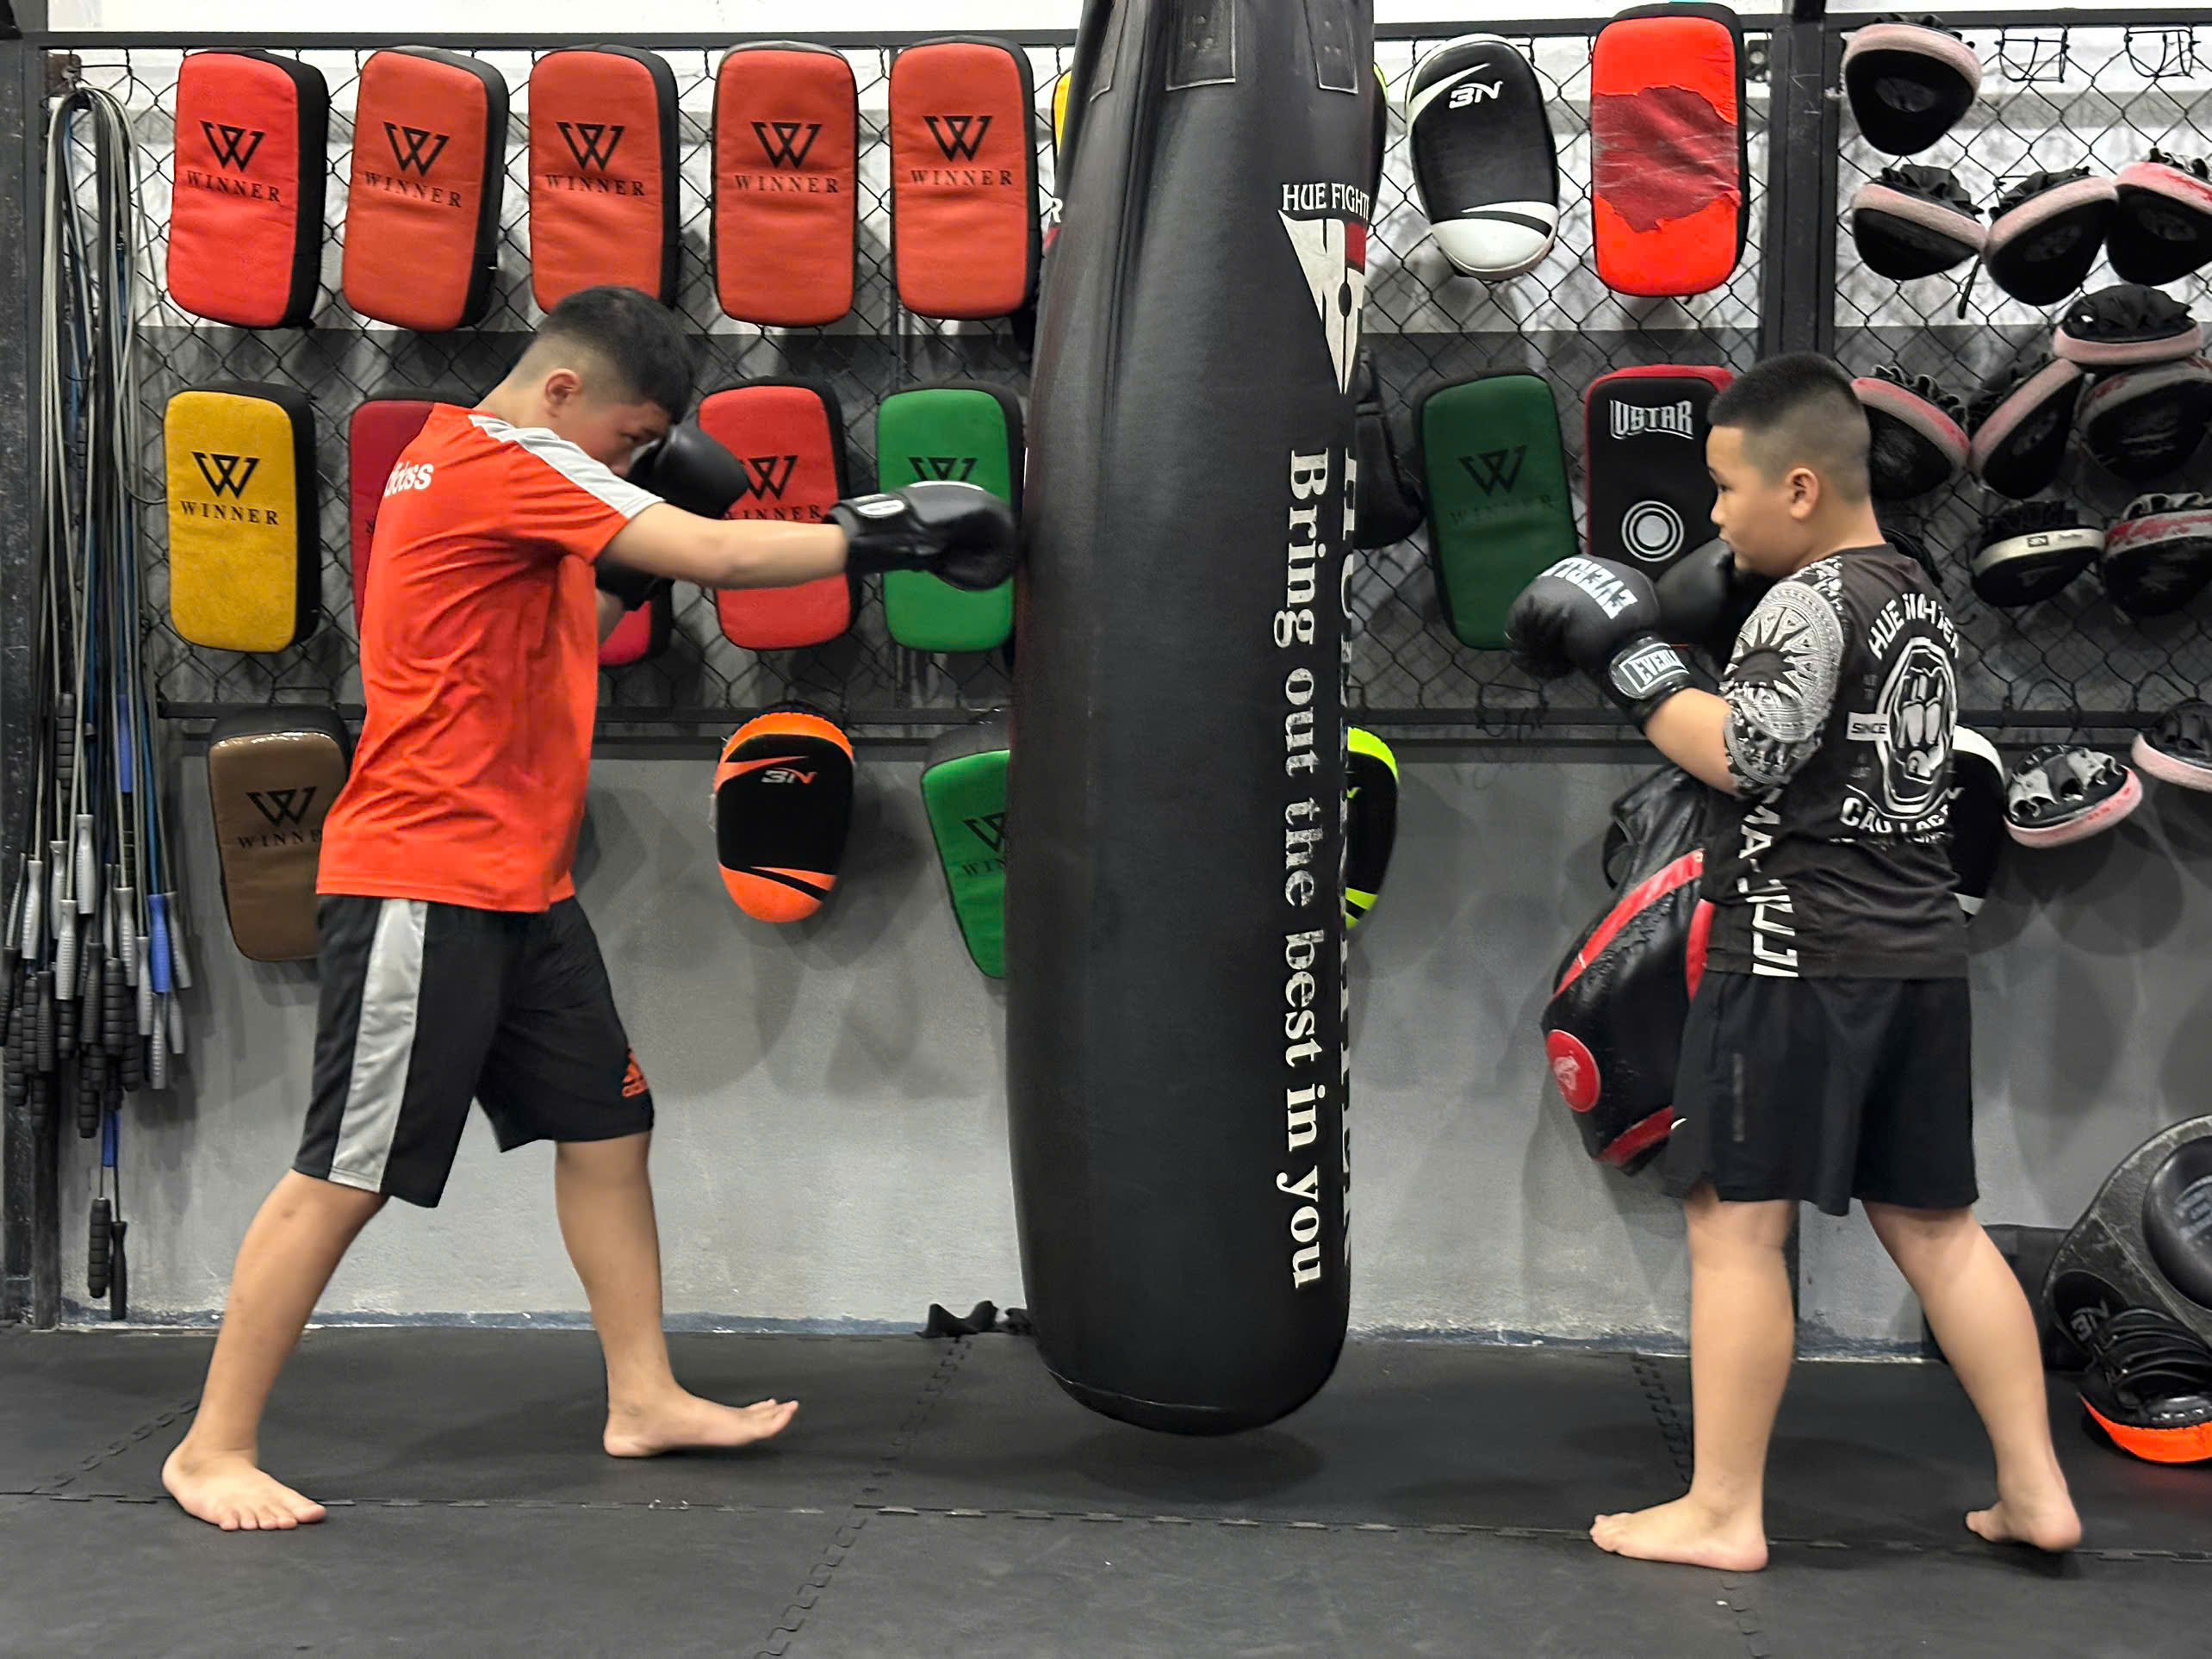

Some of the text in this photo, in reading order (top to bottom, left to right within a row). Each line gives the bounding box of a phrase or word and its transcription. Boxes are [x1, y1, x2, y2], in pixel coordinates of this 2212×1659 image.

[185, 170, 283, 203] WINNER
[363, 170, 463, 208] WINNER
[544, 171, 646, 198] WINNER
[734, 174, 840, 195] WINNER
[910, 169, 1014, 187] WINNER
[1282, 183, 1370, 221] HUE FIGHT
[180, 500, 280, 526] WINNER
[724, 503, 823, 521] INNER
[1273, 447, 1328, 1290] Bring out the best in you
